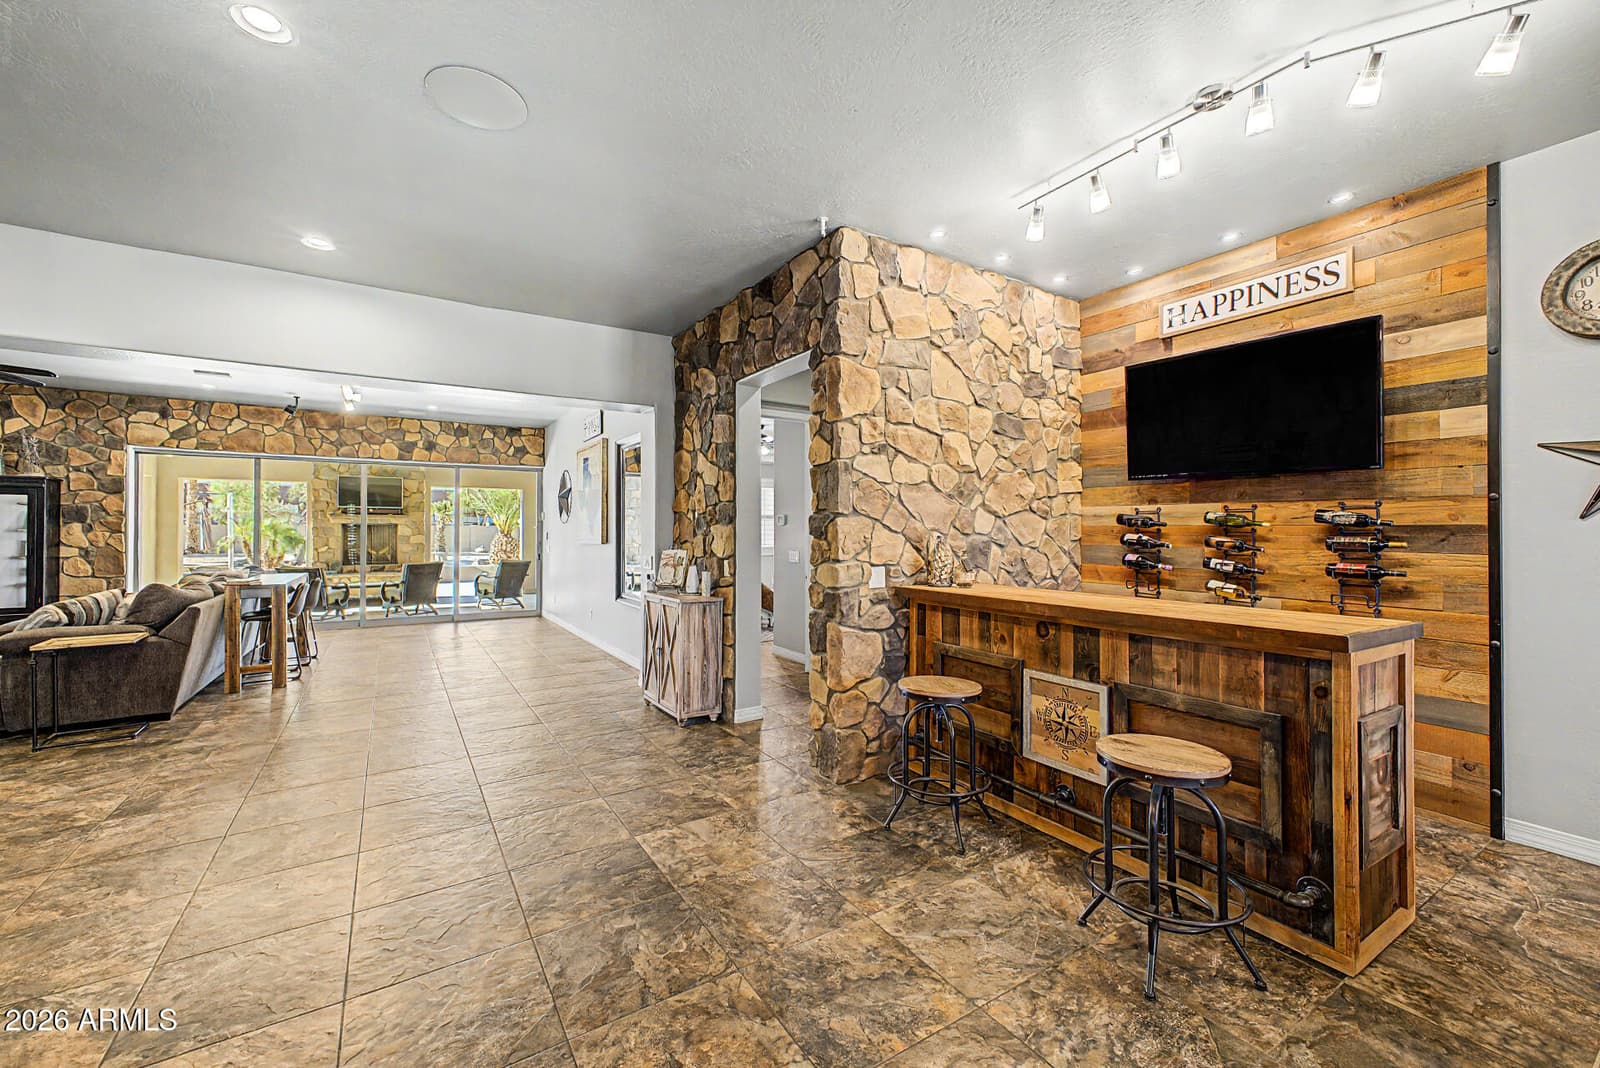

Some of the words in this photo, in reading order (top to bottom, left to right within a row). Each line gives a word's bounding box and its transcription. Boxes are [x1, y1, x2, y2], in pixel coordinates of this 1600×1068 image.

[1580, 275, 1594, 289] 10
[1167, 259, 1341, 329] HAPPINESS
[1574, 289, 1586, 301] 9
[1581, 299, 1593, 312] 8
[1061, 687, 1070, 698] N
[1089, 725, 1098, 738] E
[1061, 749, 1070, 761] S
